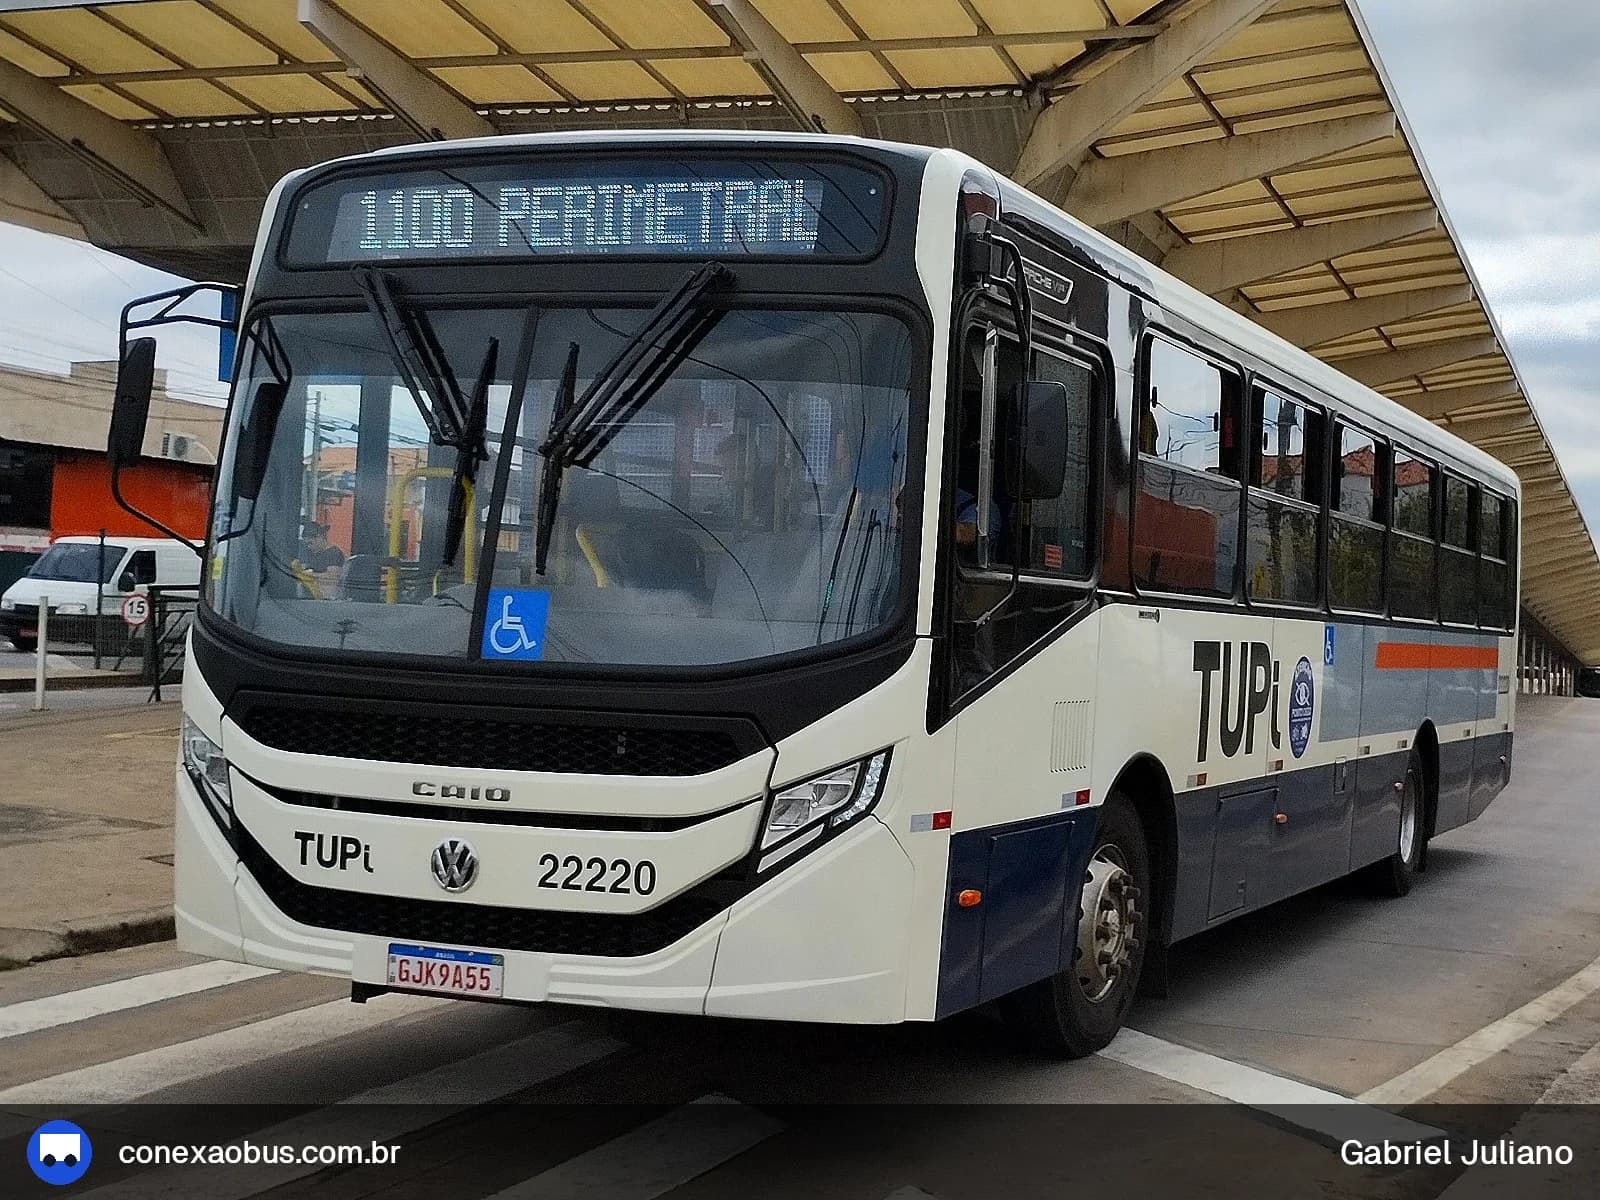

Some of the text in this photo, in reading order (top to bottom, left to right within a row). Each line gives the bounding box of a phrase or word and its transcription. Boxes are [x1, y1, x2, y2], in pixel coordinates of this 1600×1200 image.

[360, 178, 818, 248] 1100 PERIMETRAL
[128, 600, 145, 614] 15
[412, 781, 511, 802] CAIO
[537, 853, 657, 896] 22220
[398, 958, 491, 991] GJK9A55
